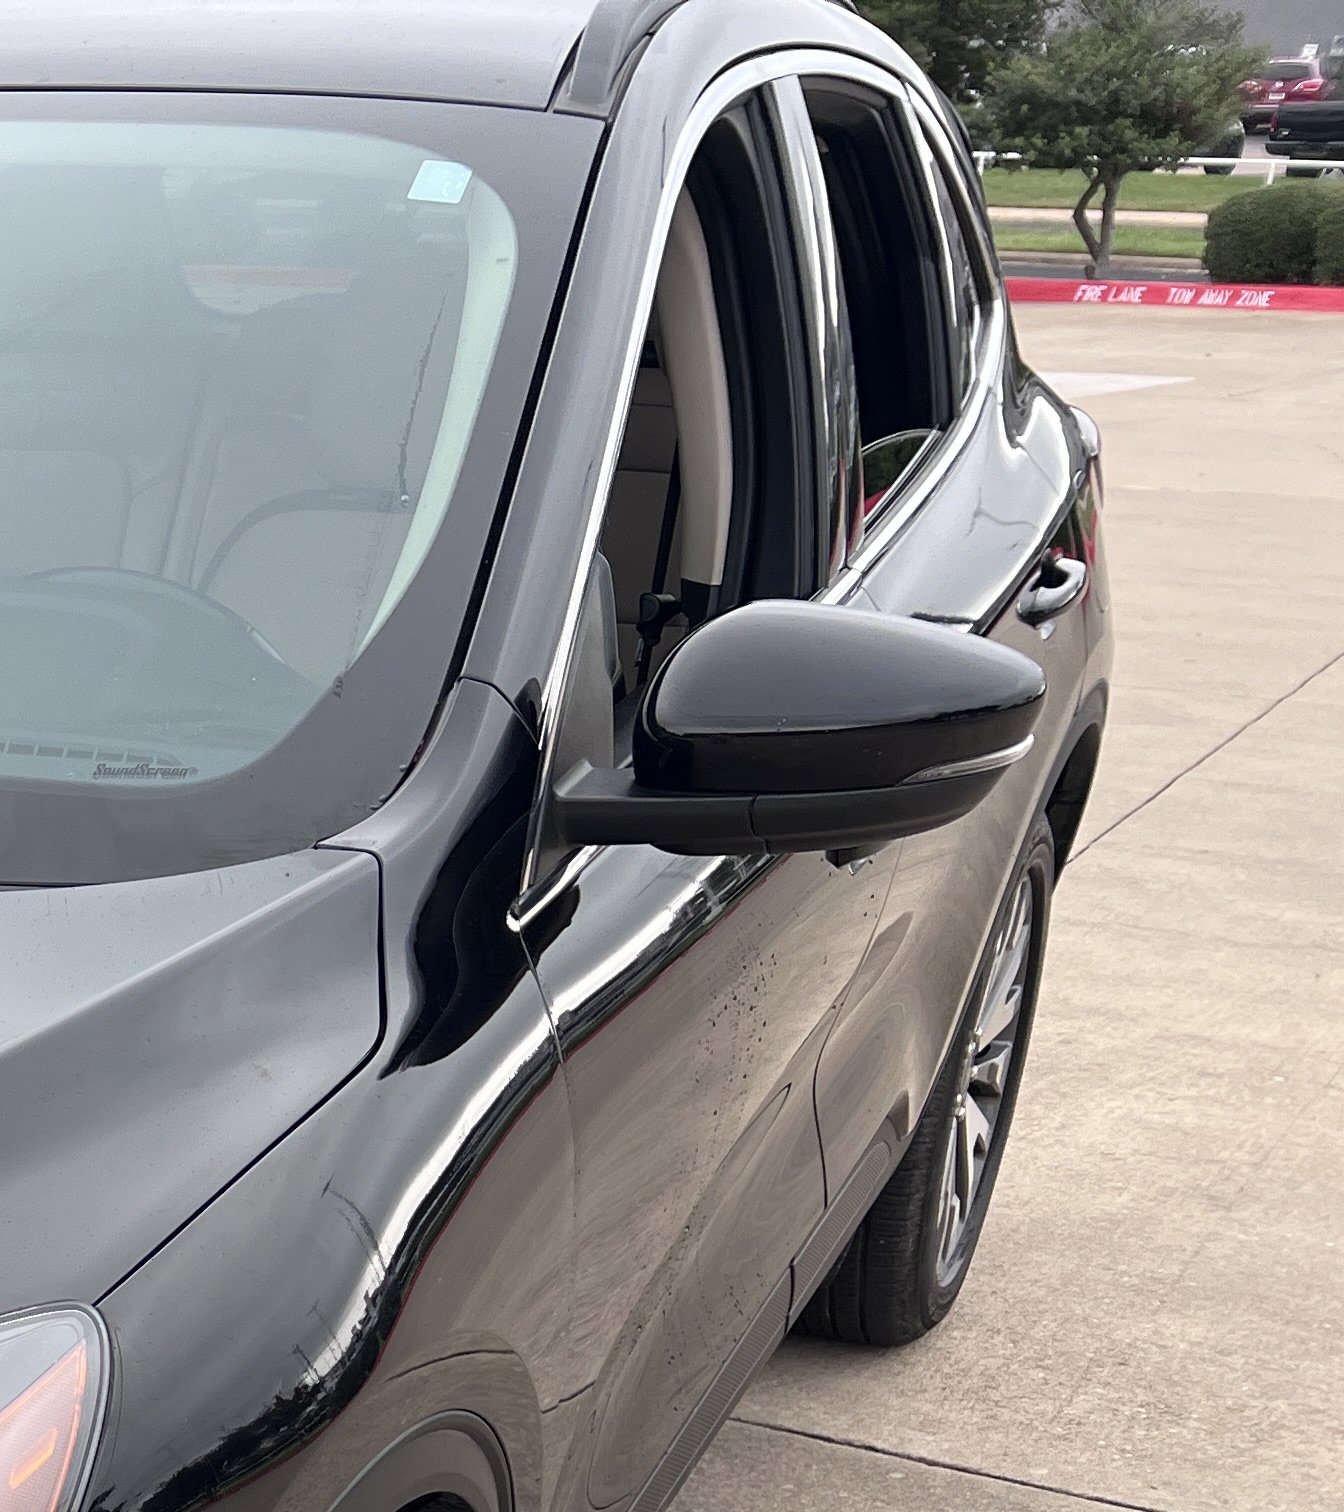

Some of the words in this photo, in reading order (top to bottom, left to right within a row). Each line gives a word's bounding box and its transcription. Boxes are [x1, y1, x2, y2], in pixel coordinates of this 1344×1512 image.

[1073, 284, 1108, 302] FIRE
[1106, 286, 1148, 303] LANE
[1166, 287, 1197, 305] TOW
[1197, 288, 1233, 306] AWAY
[1235, 290, 1276, 307] ZONE
